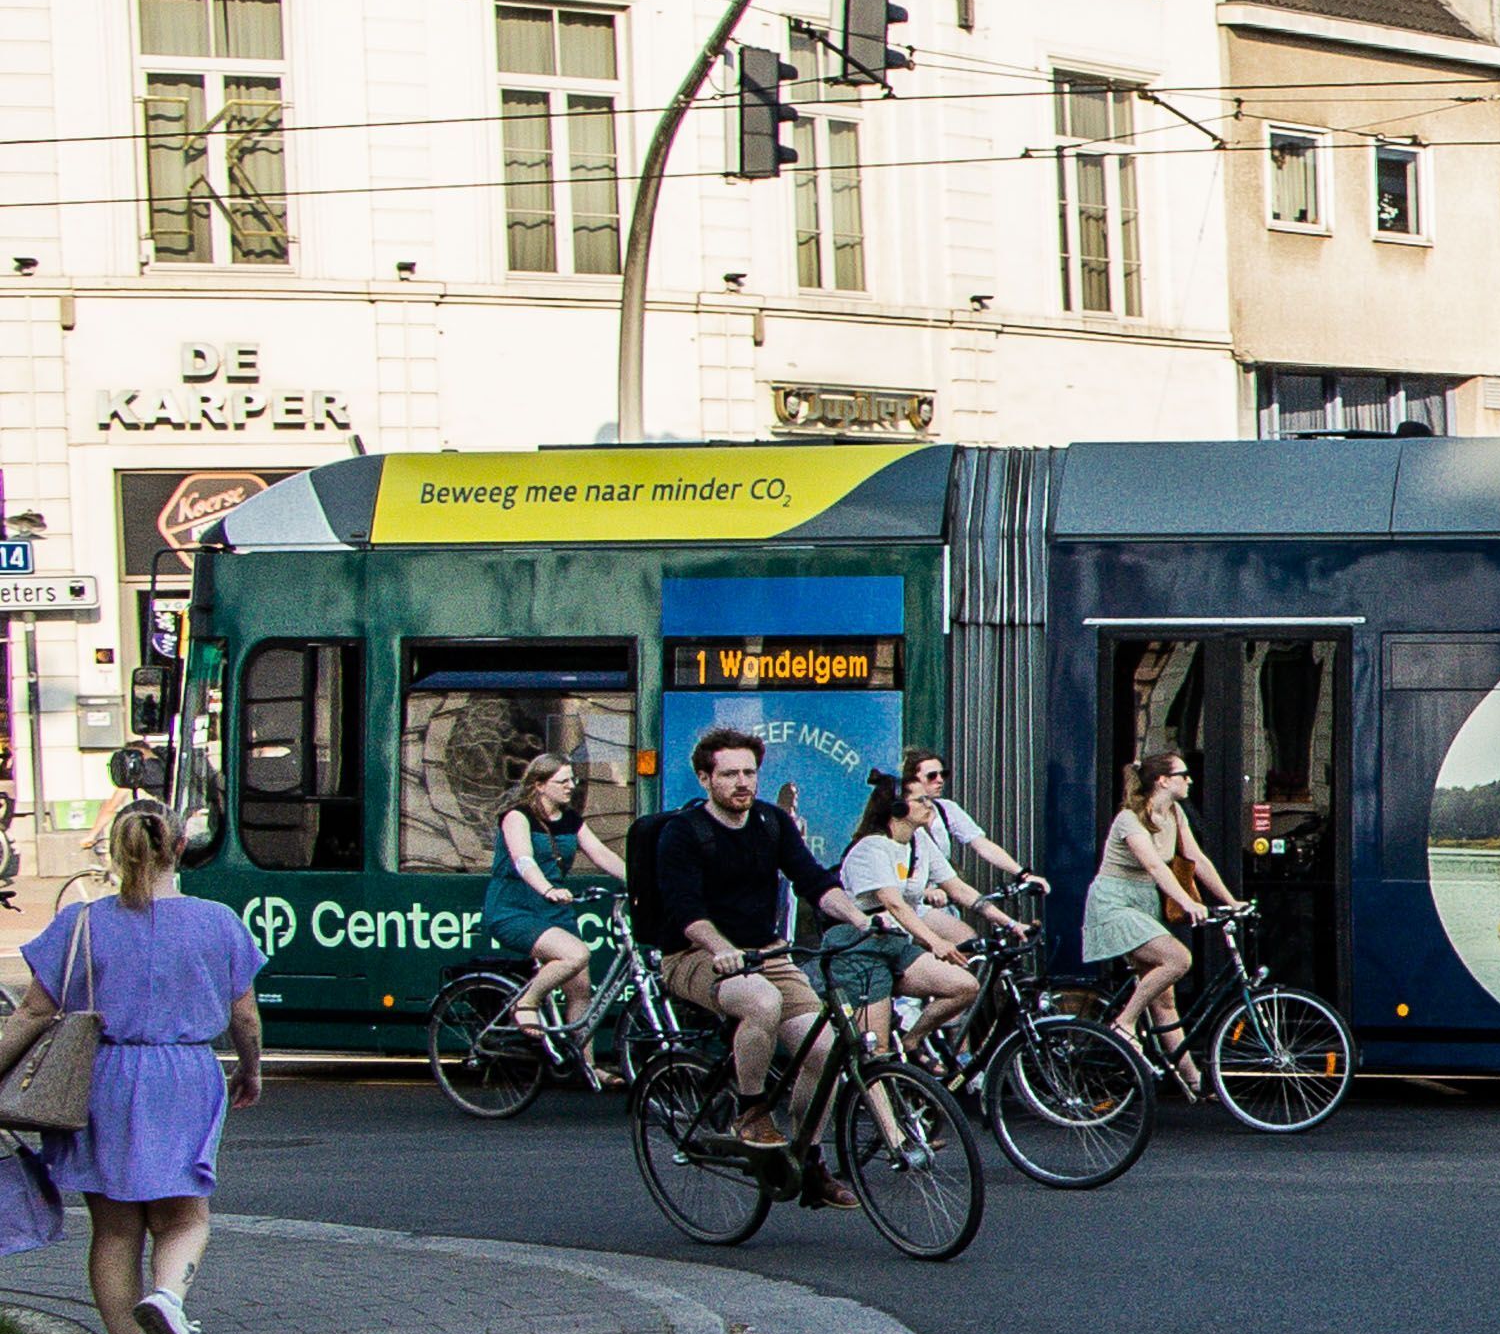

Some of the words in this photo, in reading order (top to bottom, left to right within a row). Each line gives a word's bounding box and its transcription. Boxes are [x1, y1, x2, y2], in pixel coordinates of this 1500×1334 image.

[180, 342, 260, 384] DE
[95, 389, 350, 430] KARPER
[806, 388, 913, 429] Jupiler
[420, 482, 517, 509] Beweeg
[525, 486, 576, 503] mee
[585, 482, 643, 502] naar
[651, 478, 742, 501] minder
[697, 650, 706, 685] 1
[719, 650, 868, 684] Wondelgem
[798, 724, 860, 773] MEER
[312, 901, 483, 950] Center
